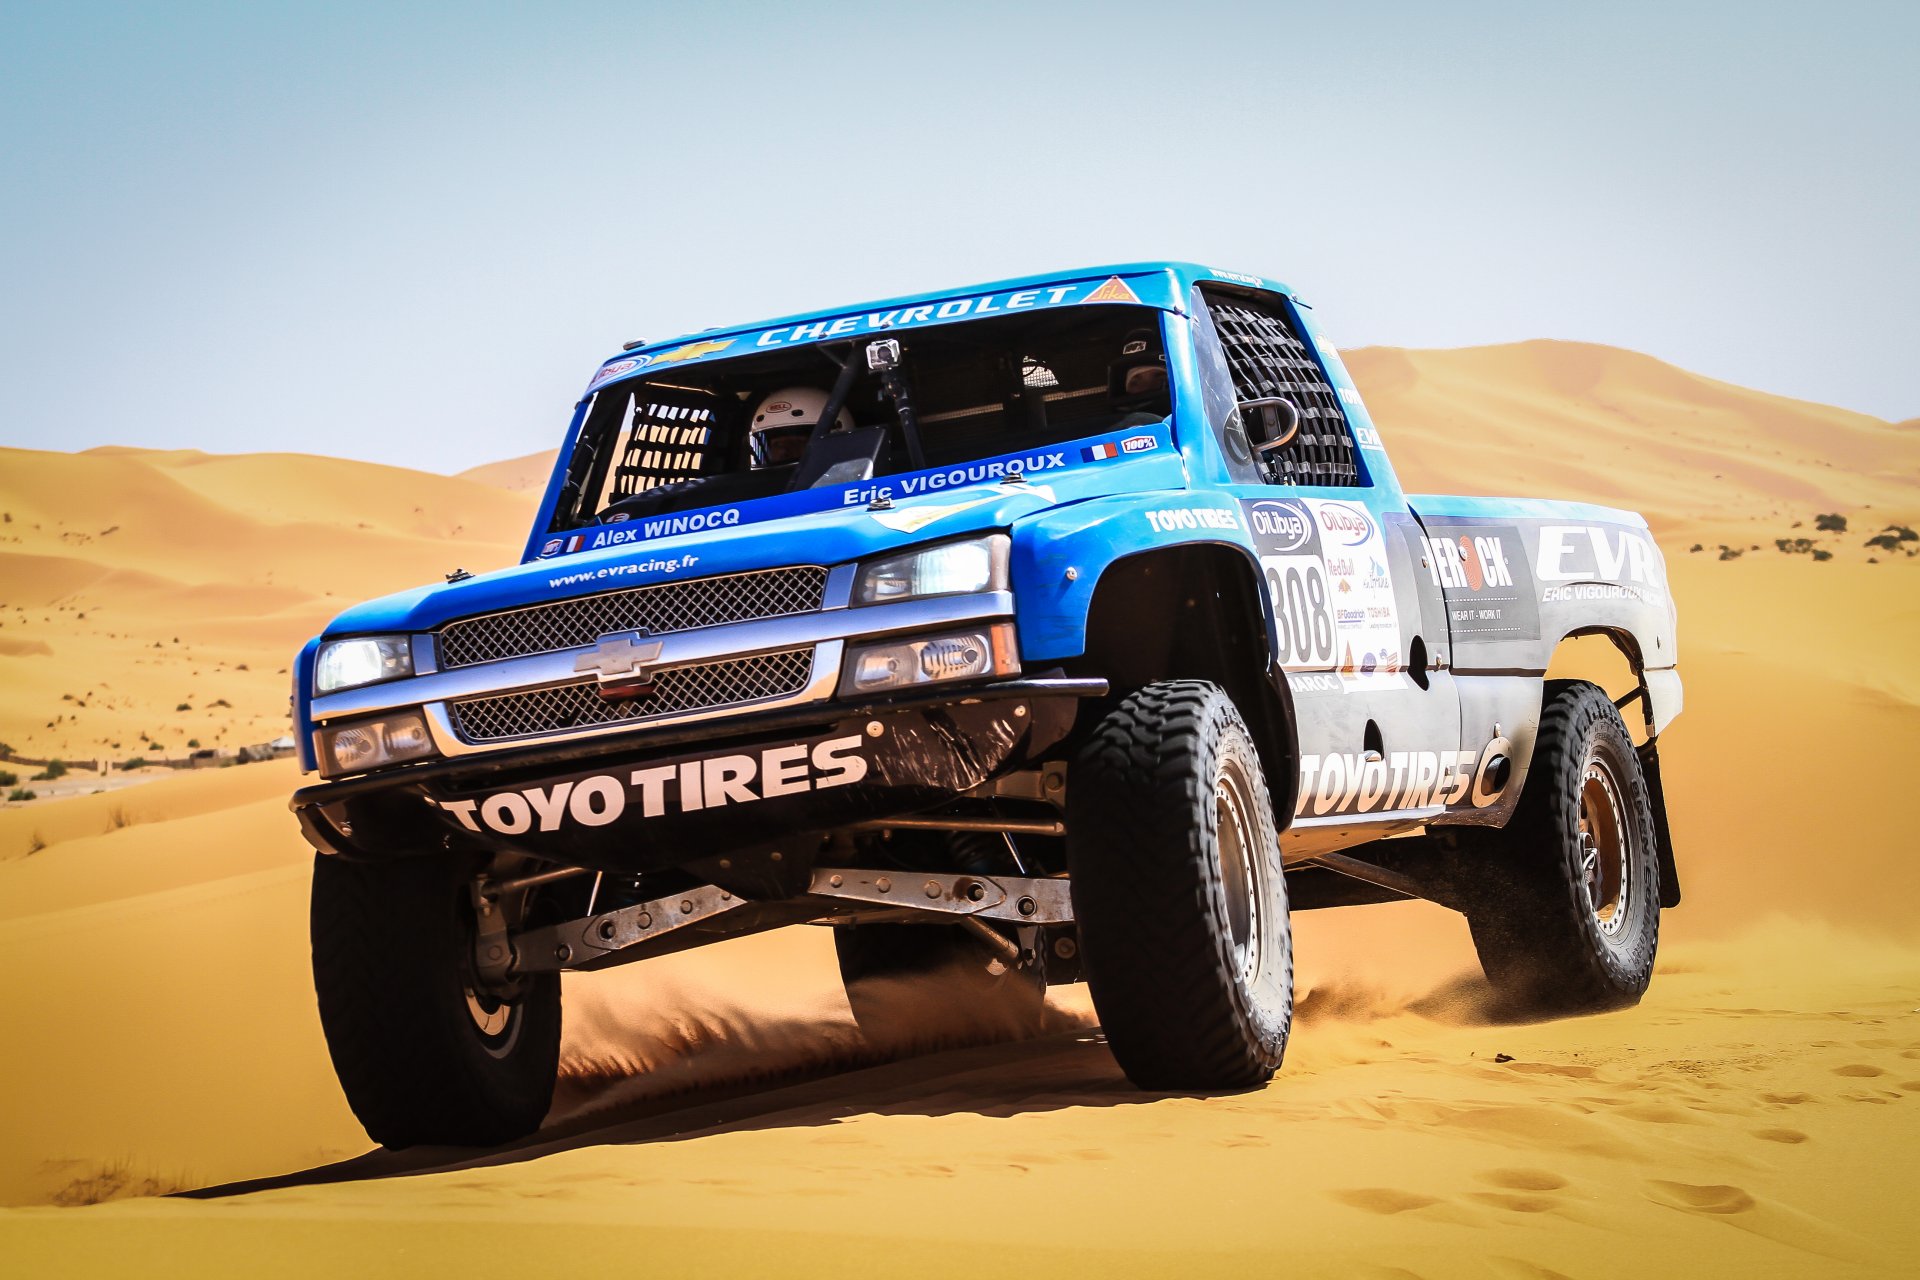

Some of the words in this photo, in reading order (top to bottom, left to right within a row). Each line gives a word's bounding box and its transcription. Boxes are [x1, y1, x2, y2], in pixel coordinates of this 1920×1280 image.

[1091, 285, 1131, 300] Sika
[757, 286, 1078, 347] CHEVROLET
[1125, 438, 1153, 451] 100%
[843, 484, 892, 505] Eric
[901, 452, 1066, 494] VIGOUROUX
[592, 529, 638, 549] Alex
[644, 508, 740, 539] WINOCQ
[1145, 509, 1196, 533] TOYO
[1192, 508, 1239, 530] TIRES
[1251, 511, 1302, 540] OiLibya
[1320, 511, 1366, 536] OiLibya
[549, 554, 699, 589] www.evracing.fr
[1536, 526, 1661, 588] EVR
[1542, 587, 1572, 602] ERIC
[1267, 566, 1332, 664] 308
[1451, 610, 1469, 621] WEAR
[1478, 609, 1496, 620] WORK
[439, 775, 625, 835] TOYO
[631, 735, 868, 818] TIRES
[1296, 751, 1388, 816] TOYO
[1382, 750, 1477, 811] TIRES
